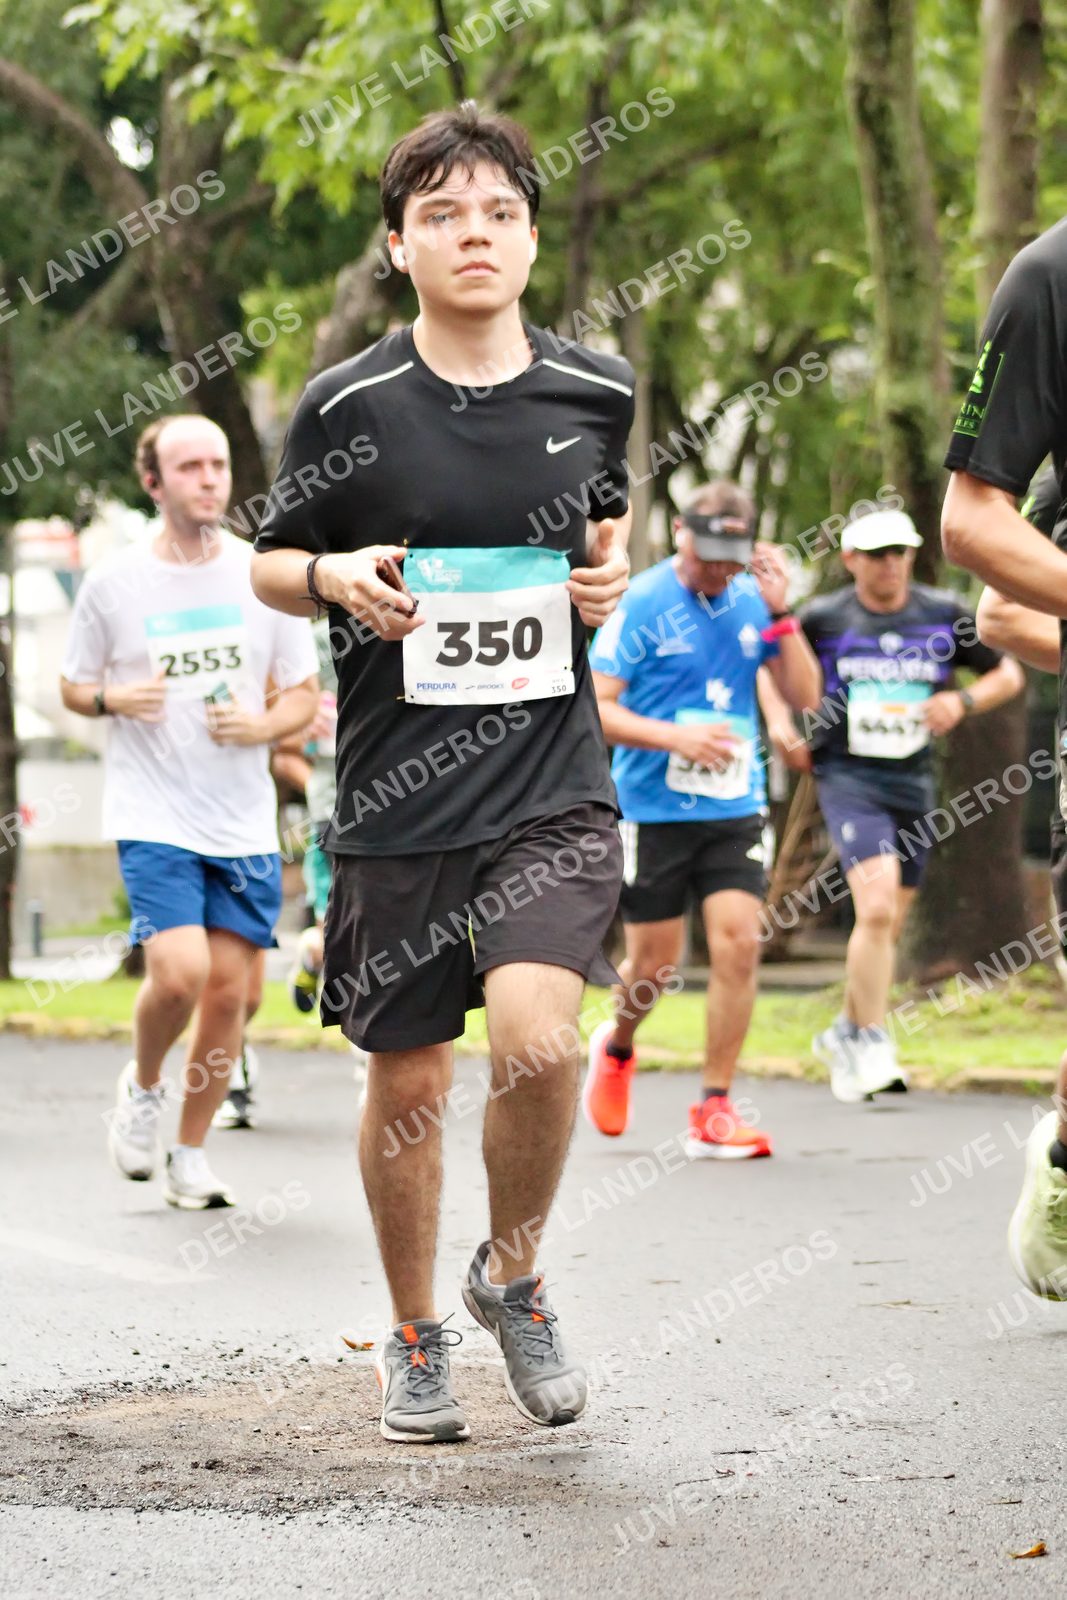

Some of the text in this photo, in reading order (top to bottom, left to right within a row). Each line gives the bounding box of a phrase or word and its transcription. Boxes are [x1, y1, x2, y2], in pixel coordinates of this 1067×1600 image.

[435, 616, 543, 667] 350
[159, 645, 241, 678] 2553
[416, 682, 457, 691] PERDURA
[551, 684, 567, 694] 350
